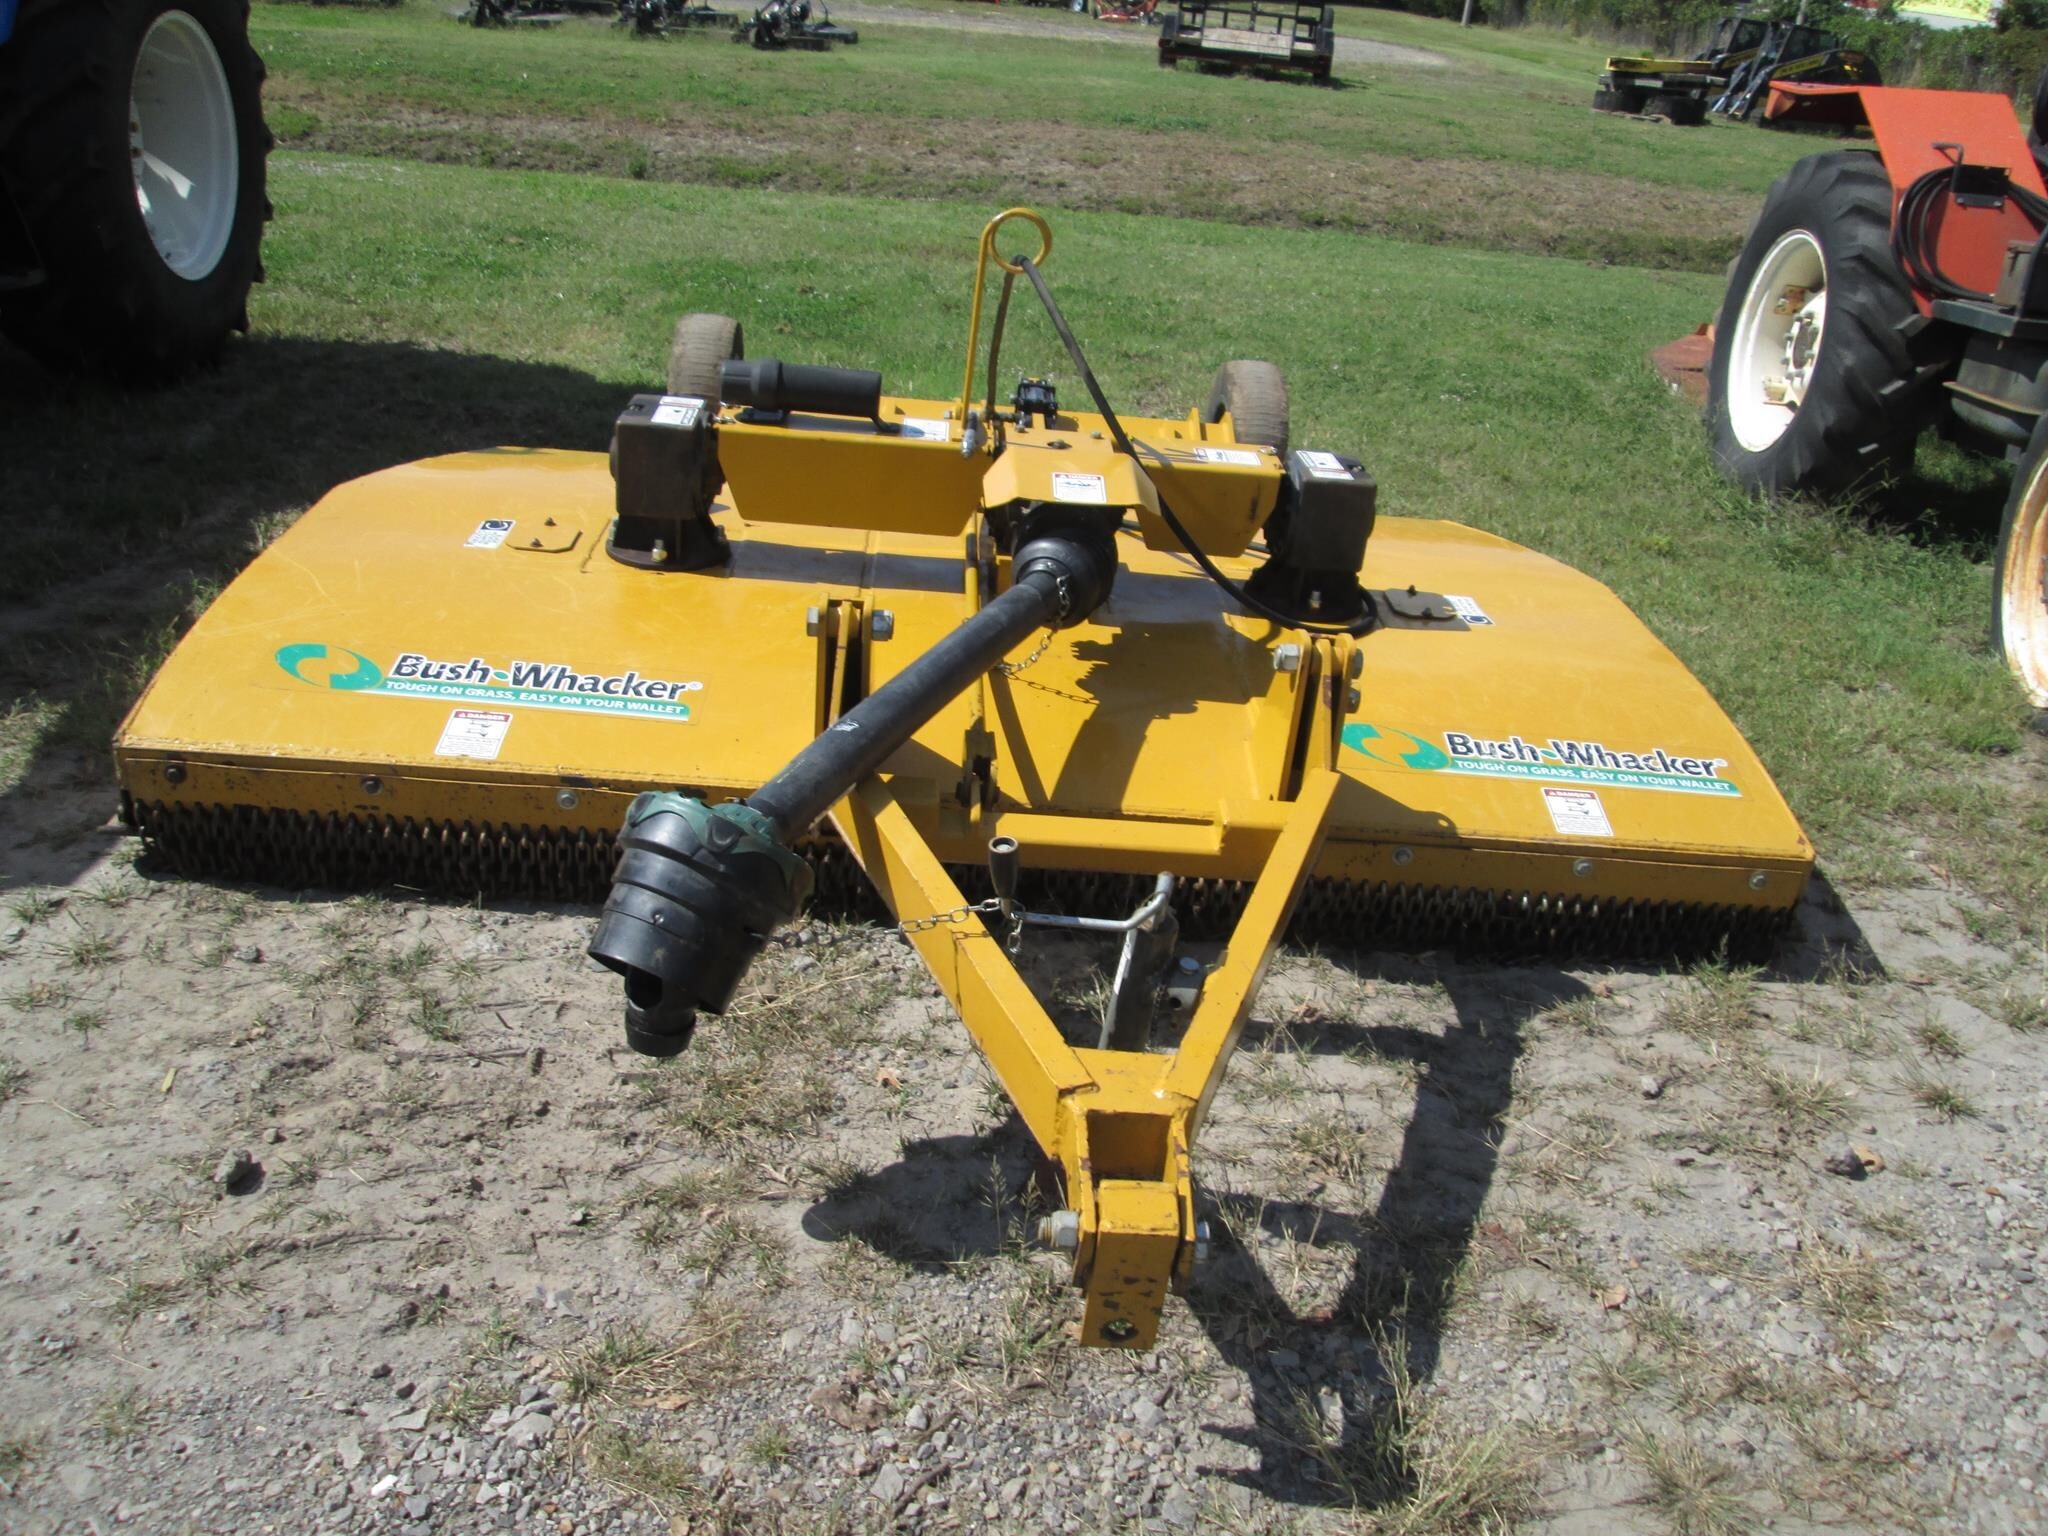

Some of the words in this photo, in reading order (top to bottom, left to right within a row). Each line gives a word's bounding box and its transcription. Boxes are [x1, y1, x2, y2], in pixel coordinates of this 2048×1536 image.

[386, 680, 436, 693] TOUGH
[440, 685, 463, 695] ON
[465, 687, 517, 700] GRASS,
[519, 692, 558, 703] EASY
[560, 694, 581, 705] ON
[585, 697, 625, 709] YOUR
[626, 700, 684, 715] WALLET
[1454, 760, 1505, 772] TOUGH
[1507, 765, 1529, 774] ON
[1580, 769, 1616, 780] EASY
[1617, 773, 1639, 783] ON
[1639, 776, 1679, 788] YOUR
[1678, 778, 1731, 791] WALLET
